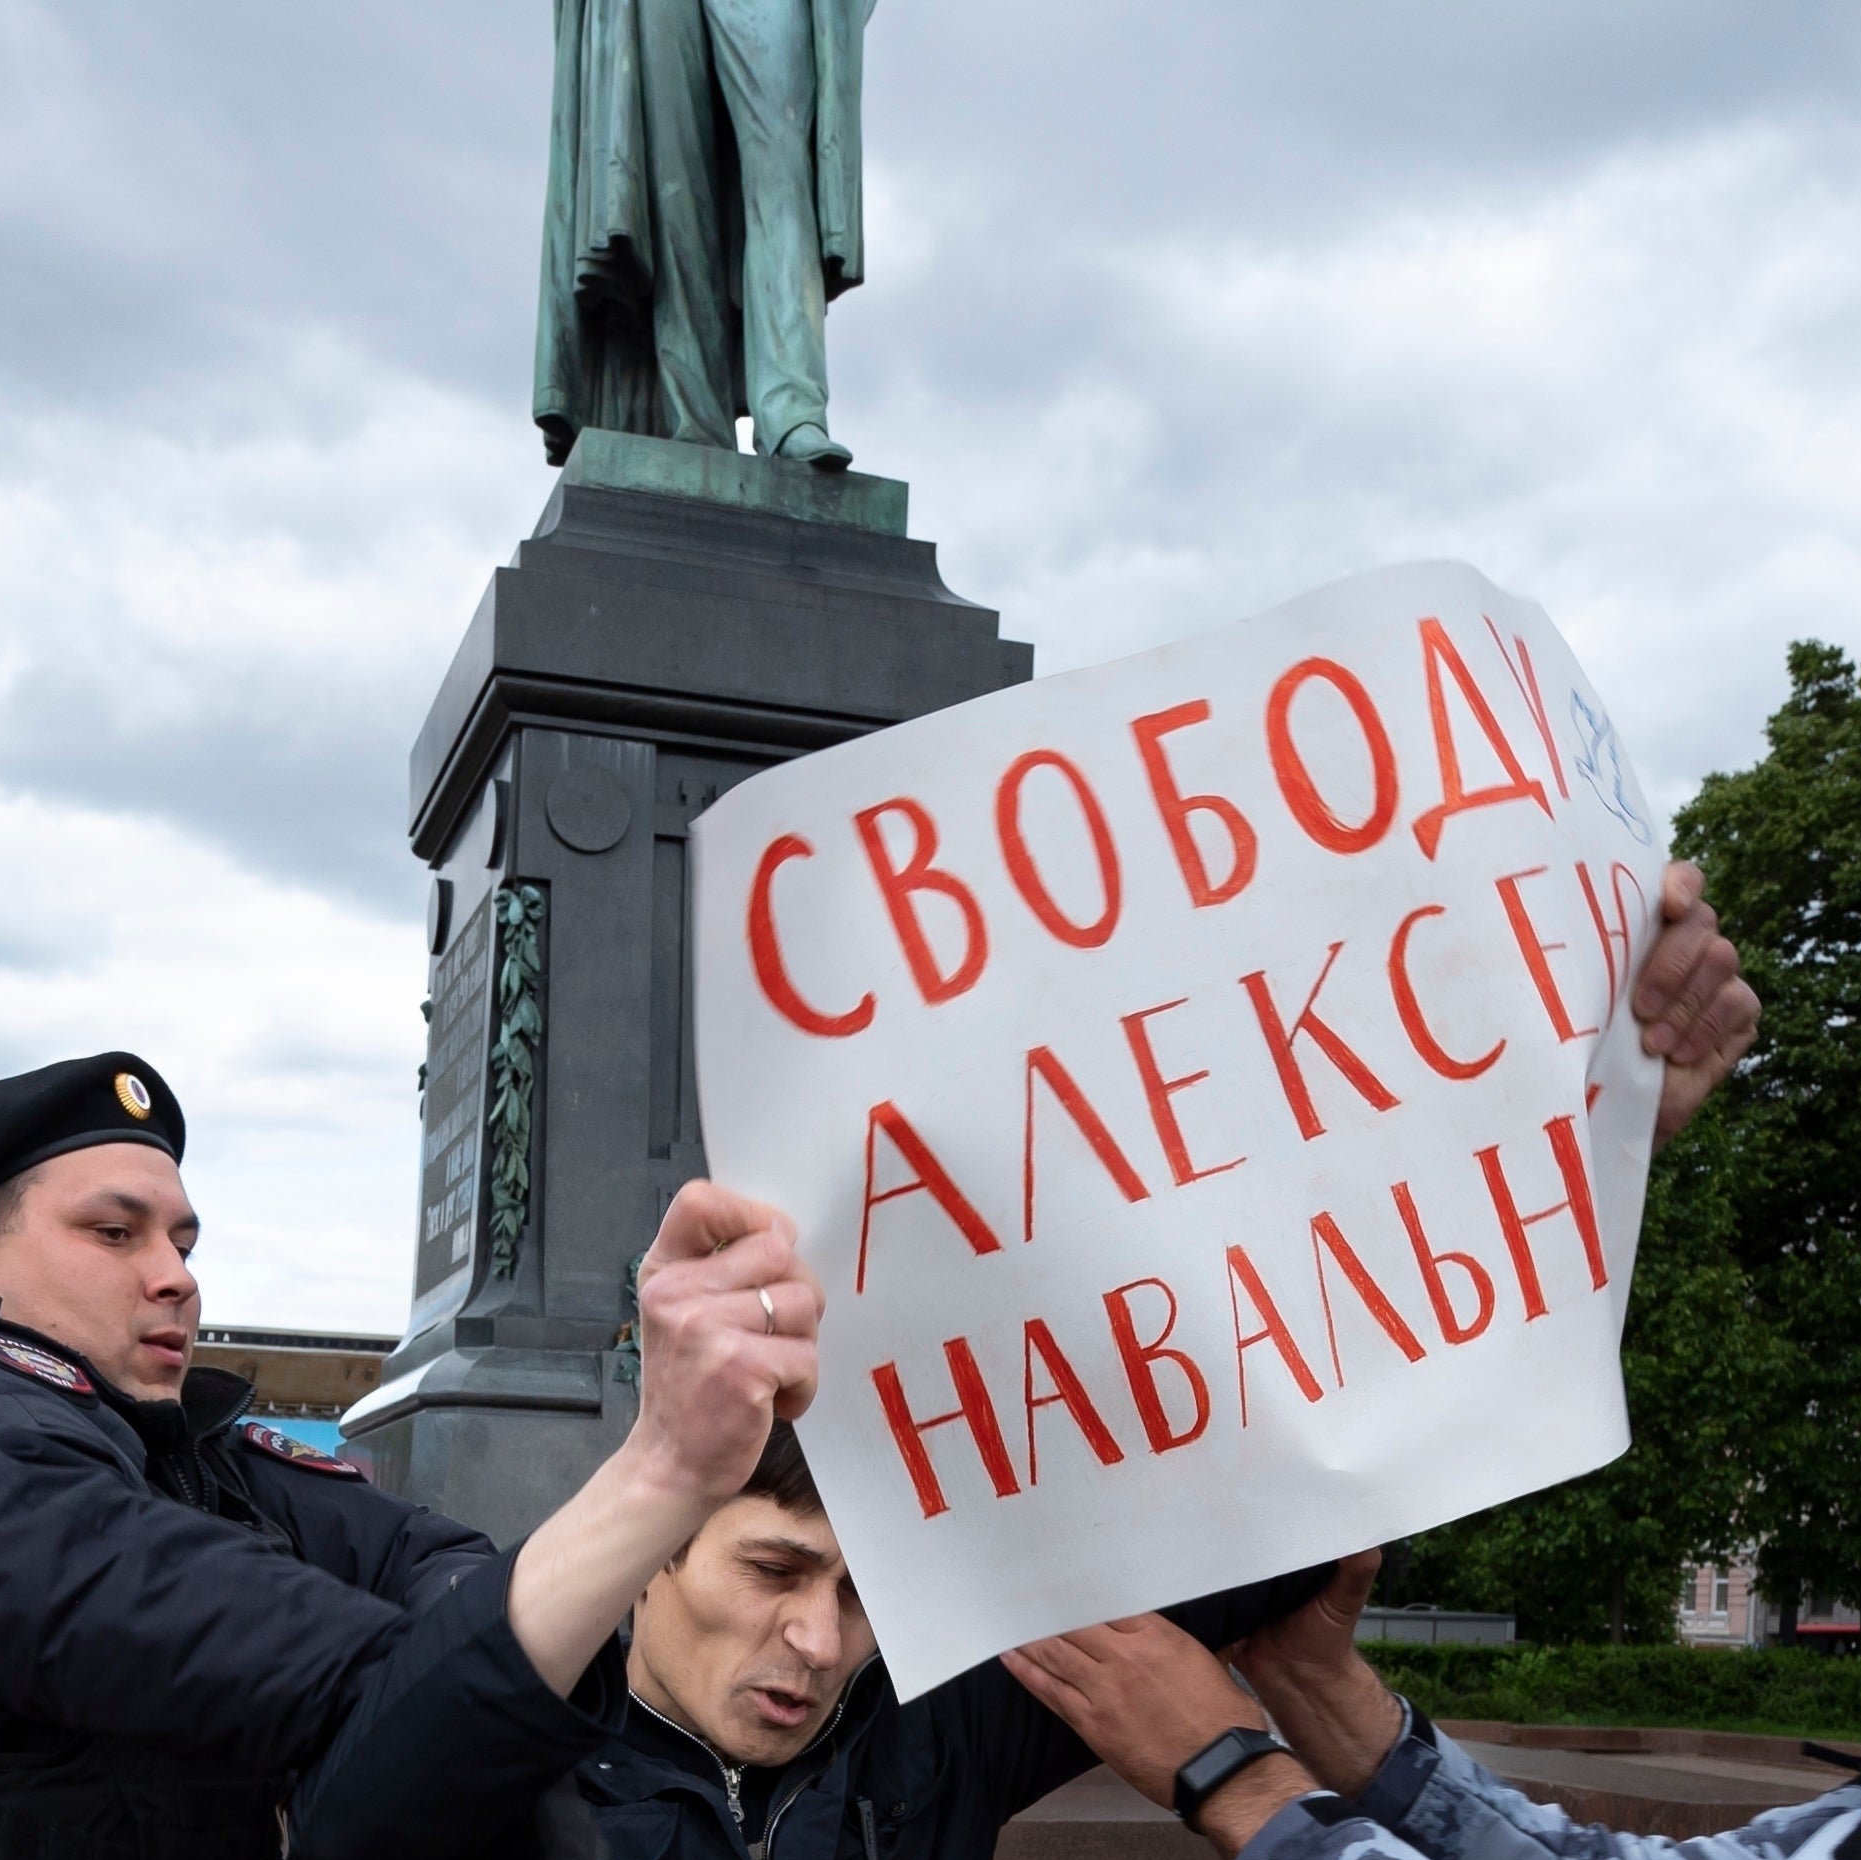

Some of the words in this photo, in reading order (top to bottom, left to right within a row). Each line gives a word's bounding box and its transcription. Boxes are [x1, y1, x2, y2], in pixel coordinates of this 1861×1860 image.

[745, 617, 1568, 1040] СВОБОДУ
[855, 863, 1648, 1294] АЛЕКСЕЮ
[869, 1084, 1609, 1521] НАВАЛЬН
